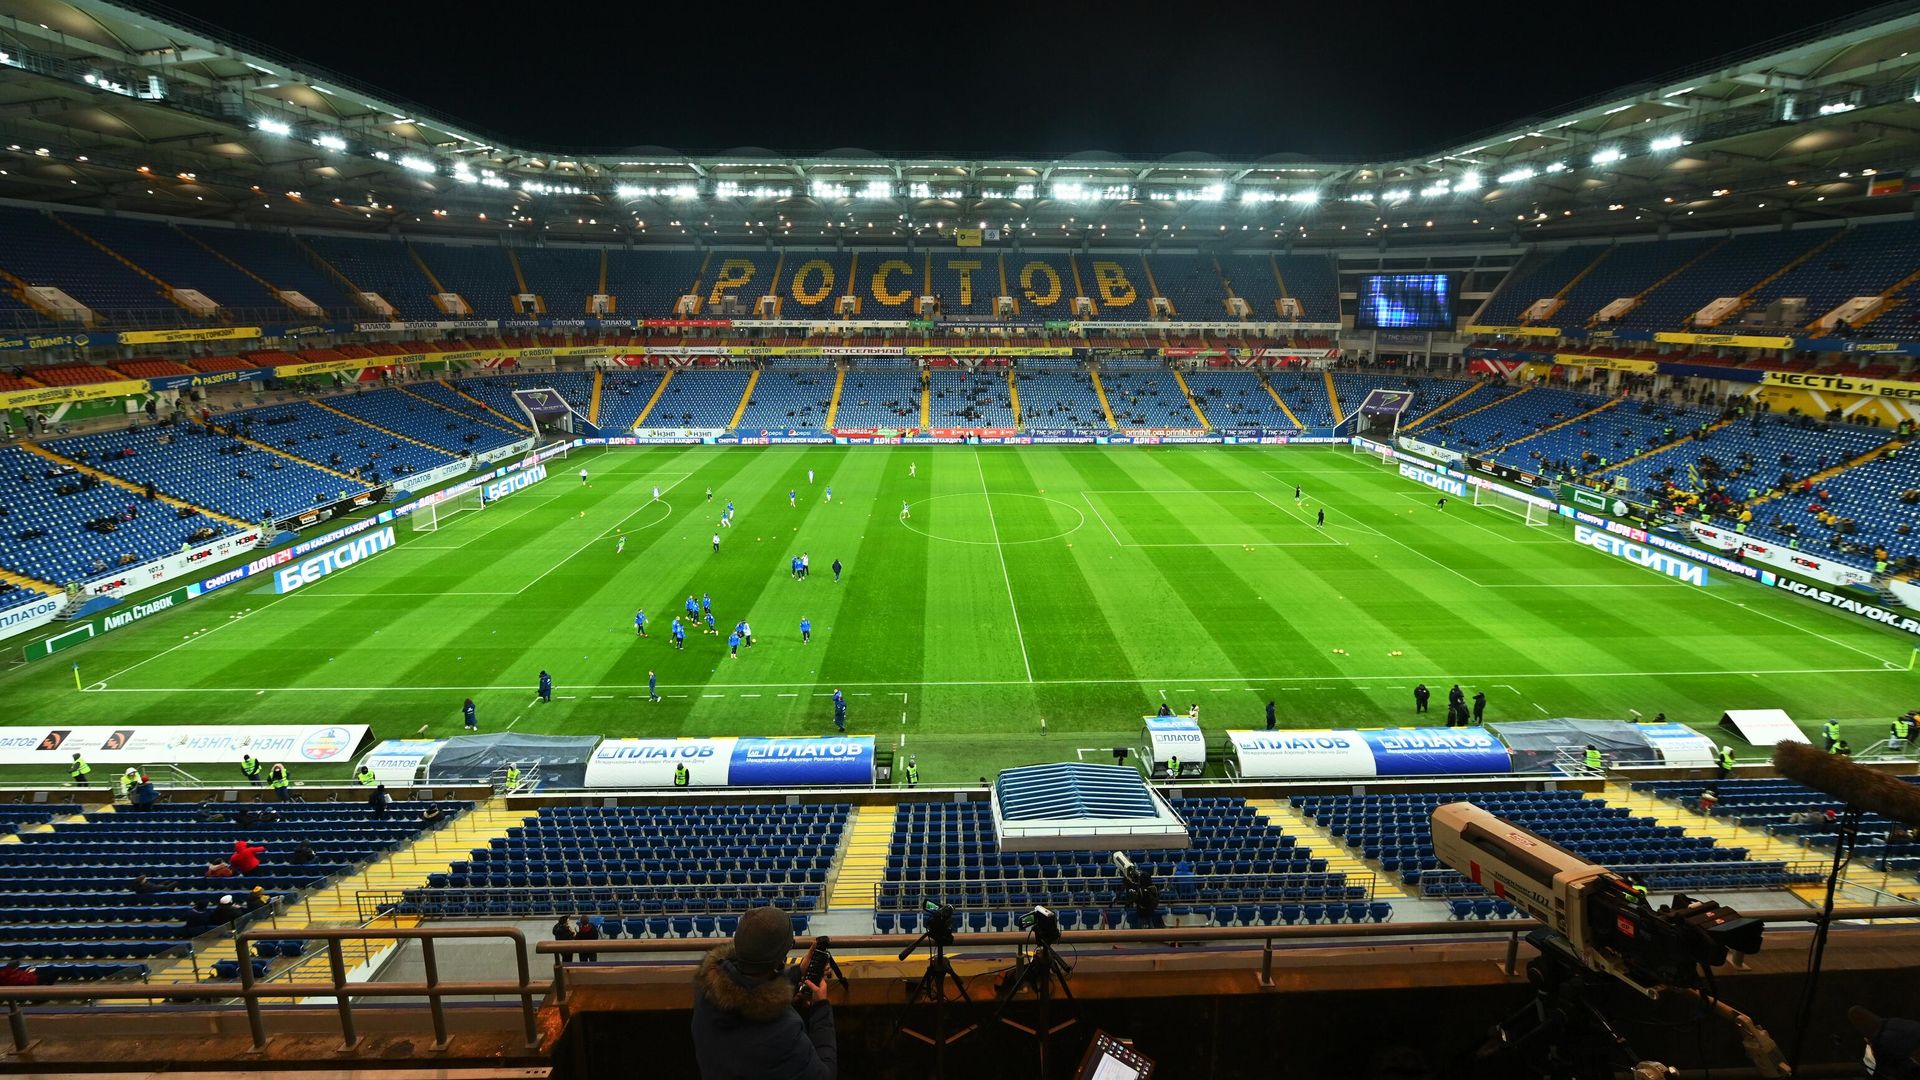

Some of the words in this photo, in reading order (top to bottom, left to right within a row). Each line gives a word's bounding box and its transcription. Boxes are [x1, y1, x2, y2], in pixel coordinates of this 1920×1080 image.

[709, 259, 1137, 307] РОСТОВ
[403, 354, 426, 362] ROSTOV
[203, 372, 237, 385] РАЗОГРЕВ
[1771, 373, 1853, 390] ЧЕСТЬ
[446, 462, 466, 473] ПЛАТОВ
[408, 474, 432, 486] ПЛАТОВ
[488, 464, 547, 499] БЕТСИТИ
[1399, 463, 1464, 497] БЕТСИТИ
[394, 502, 419, 516] СМОТРИ
[1576, 512, 1604, 529] СМОТРИ
[1606, 521, 1632, 538] ДОН
[1631, 528, 1647, 543] 24
[1649, 536, 1665, 549] ЭТО
[1665, 540, 1708, 562] КАСАЕТСЯ
[1708, 553, 1757, 578] КАЖДОГО!
[206, 569, 243, 590] СМОТРИ
[248, 556, 276, 575] ДОН
[276, 548, 293, 564] 24
[295, 544, 310, 556] ЭТО
[310, 530, 344, 551] КАСАЕТСЯ
[344, 518, 376, 537] КАЖДОГО!
[279, 526, 396, 594] БЕТСИТИ
[1574, 525, 1706, 587] БЕТСИТИ
[148, 565, 164, 574] 107.5
[0, 601, 57, 628] ПЛАТОВ
[190, 737, 232, 748] НЗНП
[250, 738, 294, 750] НЗНП
[1258, 738, 1350, 749] ПЛАТОВ
[1400, 734, 1492, 748] ПЛАТОВ
[617, 746, 715, 758] ПЛАТОВ
[768, 743, 863, 757] ПЛАТОВ
[377, 760, 418, 768] ПЛАТОВ
[1530, 891, 1550, 908] 101
